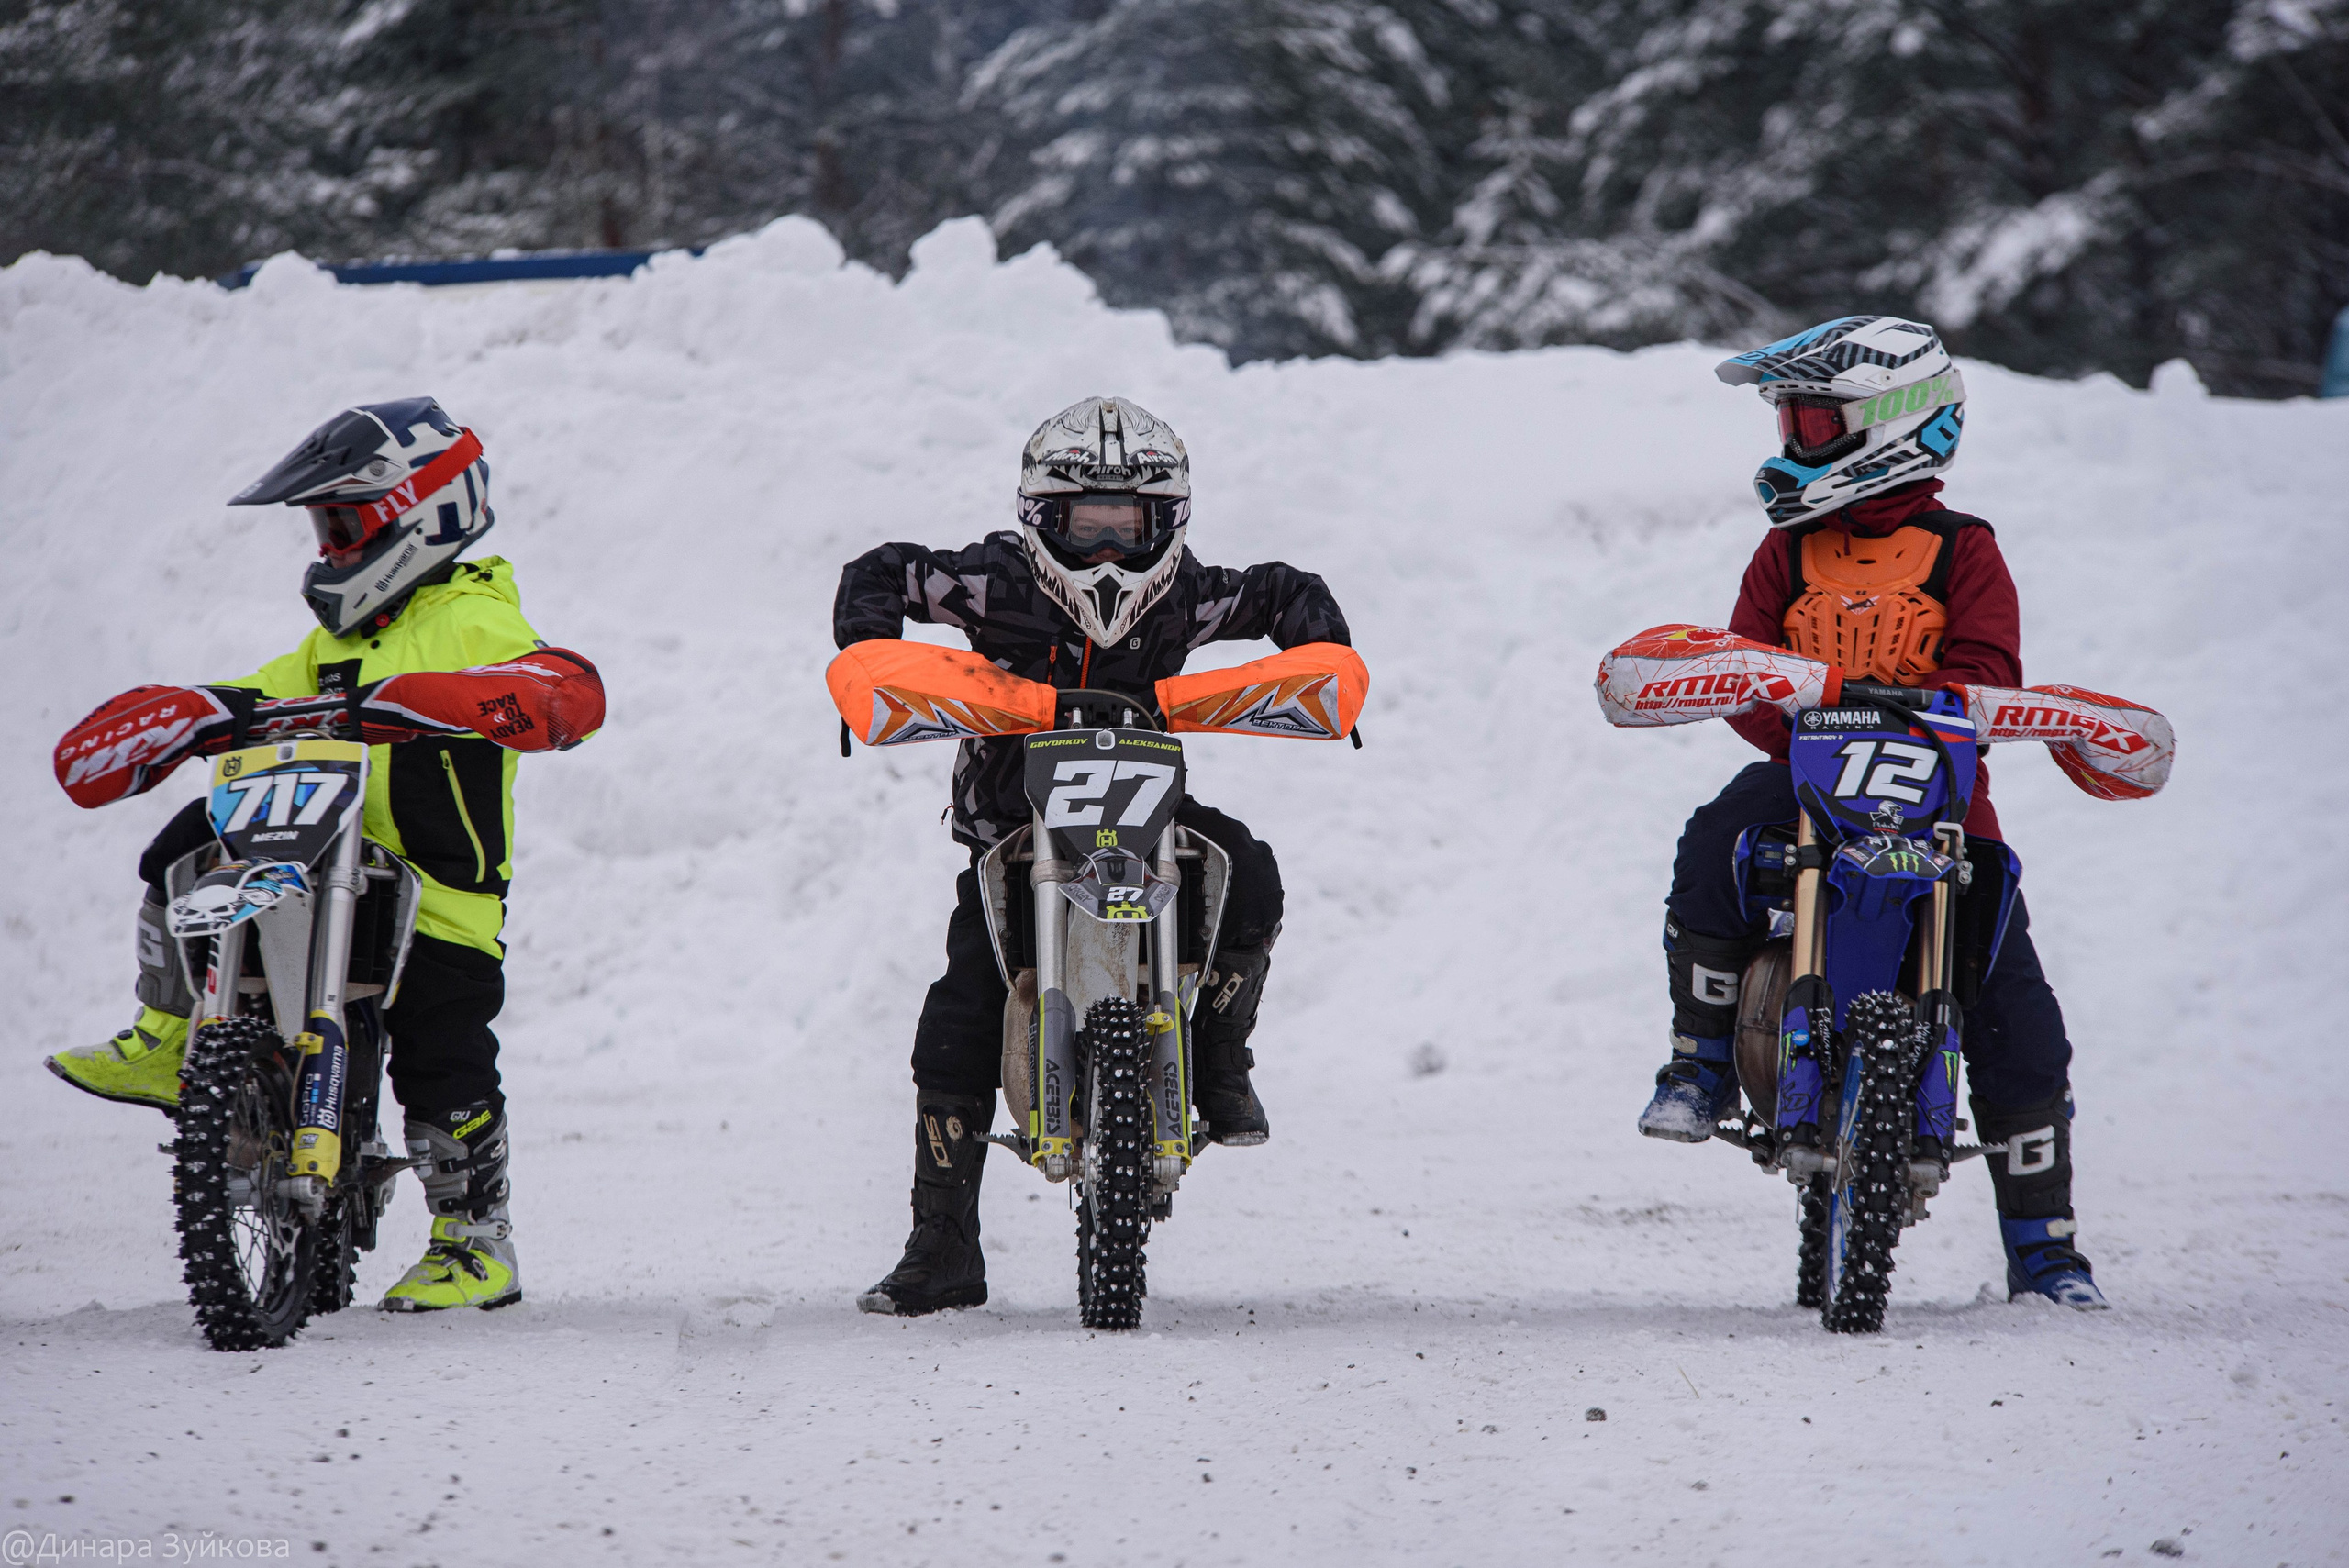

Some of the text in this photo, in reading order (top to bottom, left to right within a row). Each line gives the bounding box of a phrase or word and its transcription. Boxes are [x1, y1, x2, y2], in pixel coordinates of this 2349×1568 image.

[1858, 375, 1954, 428] 100%
[371, 479, 419, 523] FLY
[382, 542, 415, 584] Husqvarna
[477, 692, 518, 718] RACE
[1634, 695, 1734, 711] http://rmgx.ru/
[1638, 672, 1796, 706] RMGX
[1868, 687, 1904, 697] YAMAHA
[60, 704, 177, 760] RACING
[489, 715, 536, 740] READY
[507, 702, 527, 721] TO
[1822, 711, 1881, 725] YAMAHA
[1992, 705, 2151, 755] RMGX
[64, 717, 193, 787] KTM
[1030, 738, 1088, 749] GOVORKOV
[1119, 739, 1182, 752] ALEKSANDR
[1834, 741, 1939, 804] 12
[223, 773, 349, 834] 717
[1044, 760, 1176, 829] 27
[1106, 886, 1144, 902] 27
[1212, 972, 1246, 1015] SIDI
[1692, 962, 1738, 1006] G
[324, 1045, 344, 1111] Husqvarna
[923, 1113, 952, 1169] SIDI
[2008, 1124, 2055, 1176] G
